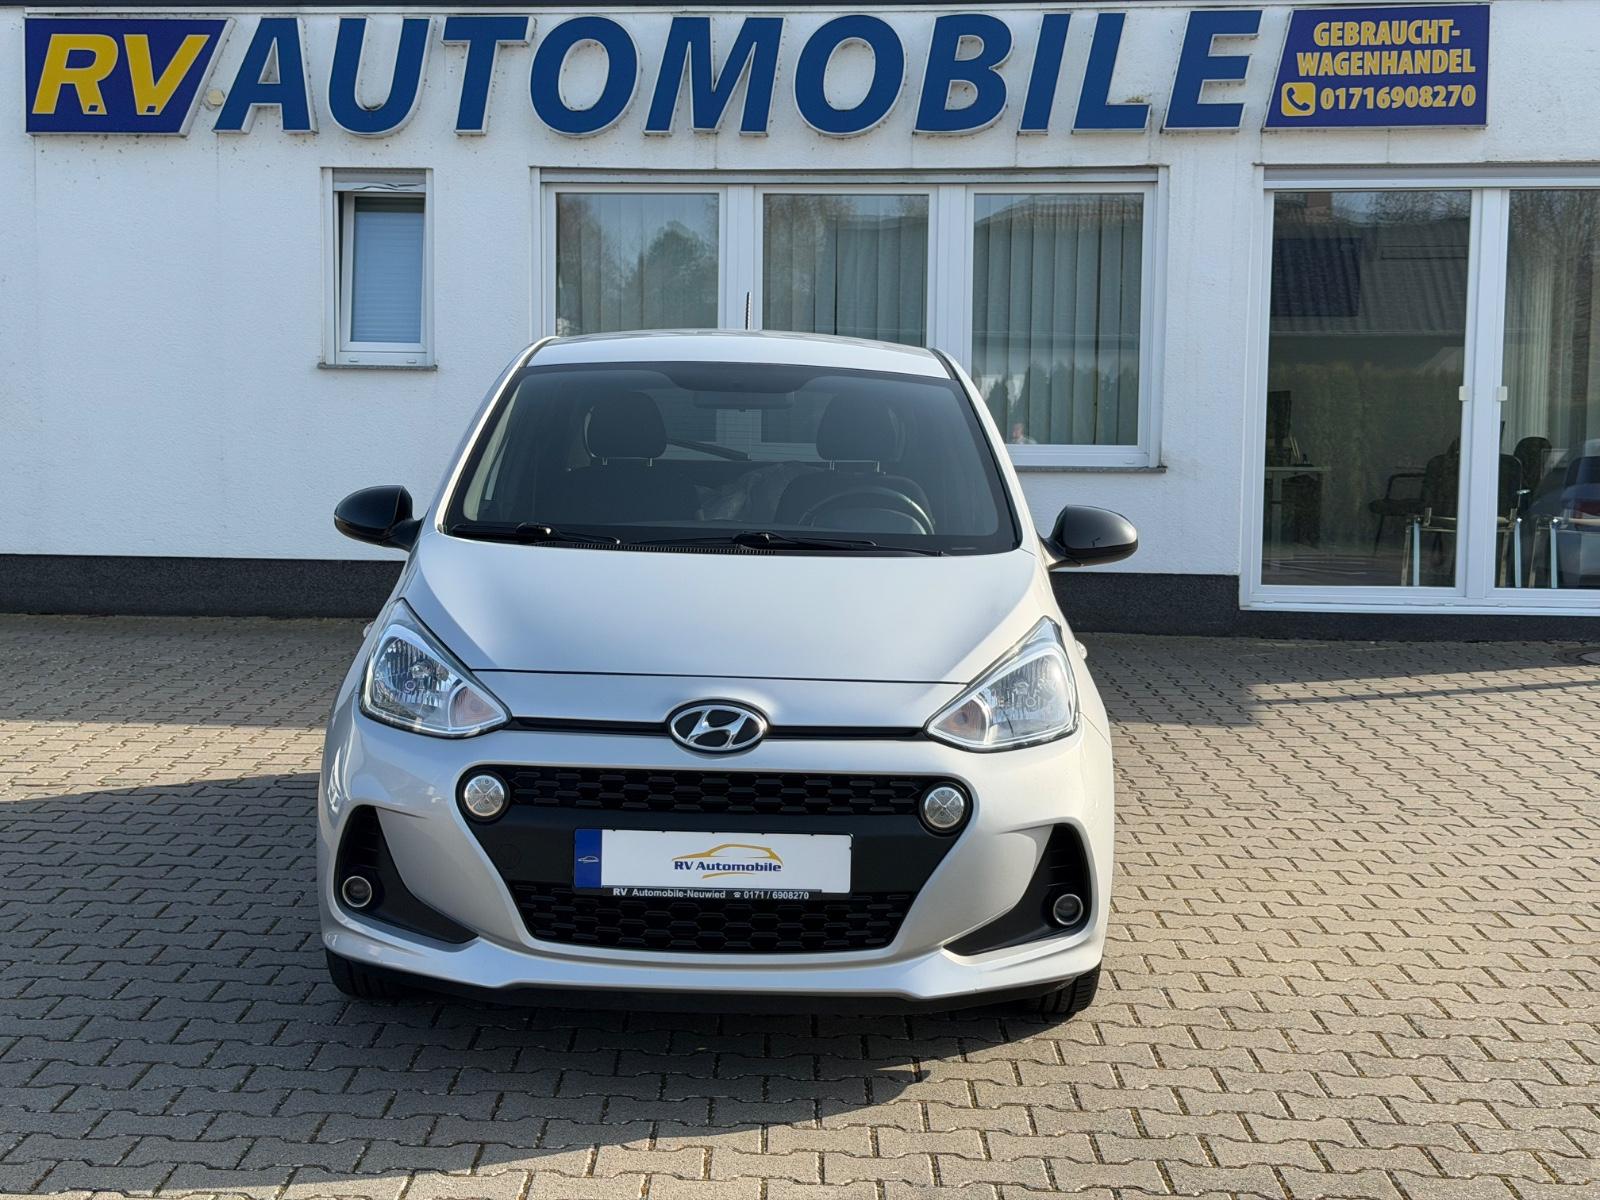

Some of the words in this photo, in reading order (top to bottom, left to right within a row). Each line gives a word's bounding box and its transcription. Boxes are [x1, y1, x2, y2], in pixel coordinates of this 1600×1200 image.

[1314, 19, 1460, 47] GEBRAUCHT-
[215, 10, 1263, 135] AUTOMOBILE
[1296, 48, 1476, 77] WAGENHANDEL
[1320, 84, 1477, 110] 01716908270
[674, 861, 694, 871] RV
[695, 860, 782, 872] Automobile
[612, 887, 628, 897] RV
[632, 888, 726, 899] Automobile-Neuwied
[772, 891, 810, 900] 6908270
